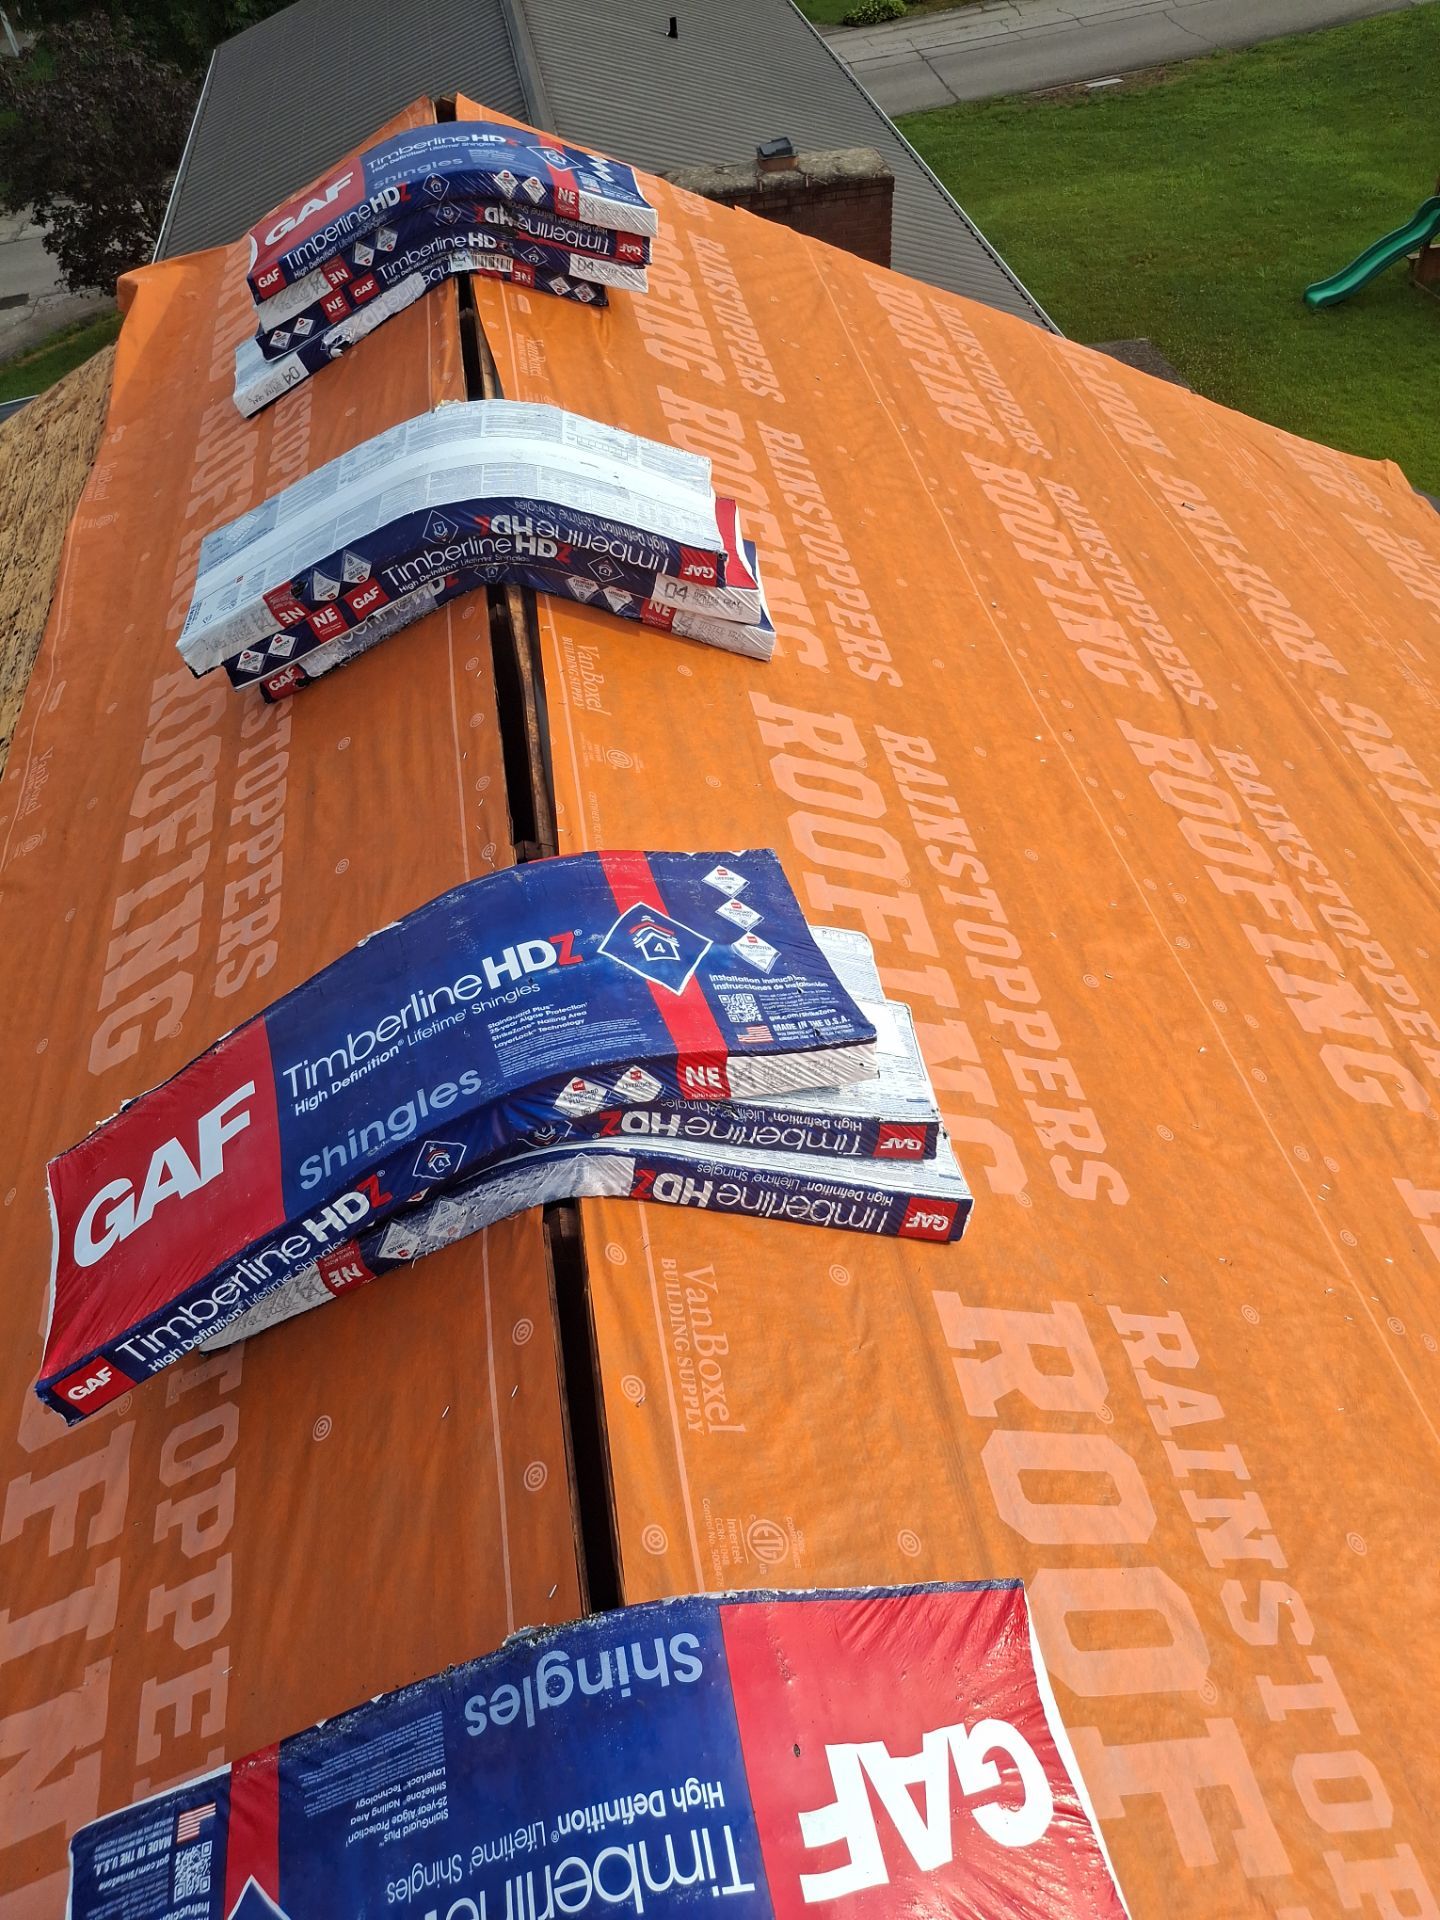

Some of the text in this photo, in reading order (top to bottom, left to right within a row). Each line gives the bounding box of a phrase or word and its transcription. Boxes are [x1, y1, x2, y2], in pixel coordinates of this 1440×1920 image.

[367, 135, 470, 169] Timberline
[265, 172, 353, 246] GAF
[557, 187, 576, 204] NE
[258, 268, 280, 289] GAF
[283, 204, 371, 270] Timberline
[517, 214, 610, 256] Timberline
[328, 268, 349, 284] NE
[354, 236, 467, 297] GAF Timberline
[326, 296, 343, 312] NE
[688, 228, 786, 404] RAINSTOPPERS
[756, 419, 904, 688] RAINSTOPPERS
[352, 586, 380, 610] GAF
[382, 534, 511, 586] Timberline
[515, 534, 574, 564] HDZ
[683, 564, 714, 579] GAF
[961, 451, 1165, 702] ROOFING
[664, 582, 687, 600] 04
[1038, 476, 1218, 711] RAINSTOPPERS
[279, 607, 305, 624] NE
[313, 607, 338, 628] NE
[649, 601, 671, 617] NE
[268, 667, 296, 691] GAF
[577, 644, 612, 716] VanBoxel
[88, 668, 228, 1077] ROOFING
[1115, 718, 1431, 1113] ROOFING
[873, 724, 1131, 1206] RAINSTOPPERS
[283, 974, 483, 1098] Timberline
[482, 931, 584, 990] HDZ
[487, 1008, 531, 1030] StainGuard
[520, 1011, 544, 1023] Algae
[538, 1018, 585, 1033] Technology
[568, 1010, 588, 1019] Area
[773, 1016, 851, 1032] MADE IN THE U.S.A.
[295, 1089, 328, 1116] High
[331, 1045, 400, 1094] Definition
[472, 982, 541, 1015] Shingles
[685, 1065, 722, 1087] NE
[299, 1068, 483, 1190] Shingles
[600, 1111, 922, 1156] GAF Timberline HDZ
[833, 1118, 862, 1132] High
[73, 1079, 256, 1268] GAF
[697, 1163, 749, 1182] Shingles
[631, 1168, 949, 1233] GAF Timberline HDZ
[806, 1181, 866, 1202] Definition
[867, 1191, 894, 1206] High
[68, 1366, 113, 1401] GAF
[115, 1234, 311, 1362] Timberline
[302, 1174, 393, 1243] HDZ
[329, 1262, 363, 1287] NE
[148, 1344, 183, 1373] High
[661, 1257, 704, 1436] BUILDING SUPPLY
[683, 1263, 747, 1434] VanBoxel
[726, 1518, 744, 1564] Intertek
[464, 1632, 704, 1736] Shingles
[350, 1781, 447, 1826] StrikeZone Nailing Area
[355, 1784, 402, 1809] Technology
[671, 1777, 725, 1810] High
[391, 1808, 417, 1824] Algae
[403, 1809, 449, 1837] StainGuard
[559, 1789, 666, 1834] Definition
[798, 1718, 1054, 1904] GAF
[120, 1850, 136, 1862] THE
[137, 1846, 146, 1856] IN
[147, 1835, 172, 1851] MADE
[386, 1853, 463, 1904] Shingles
